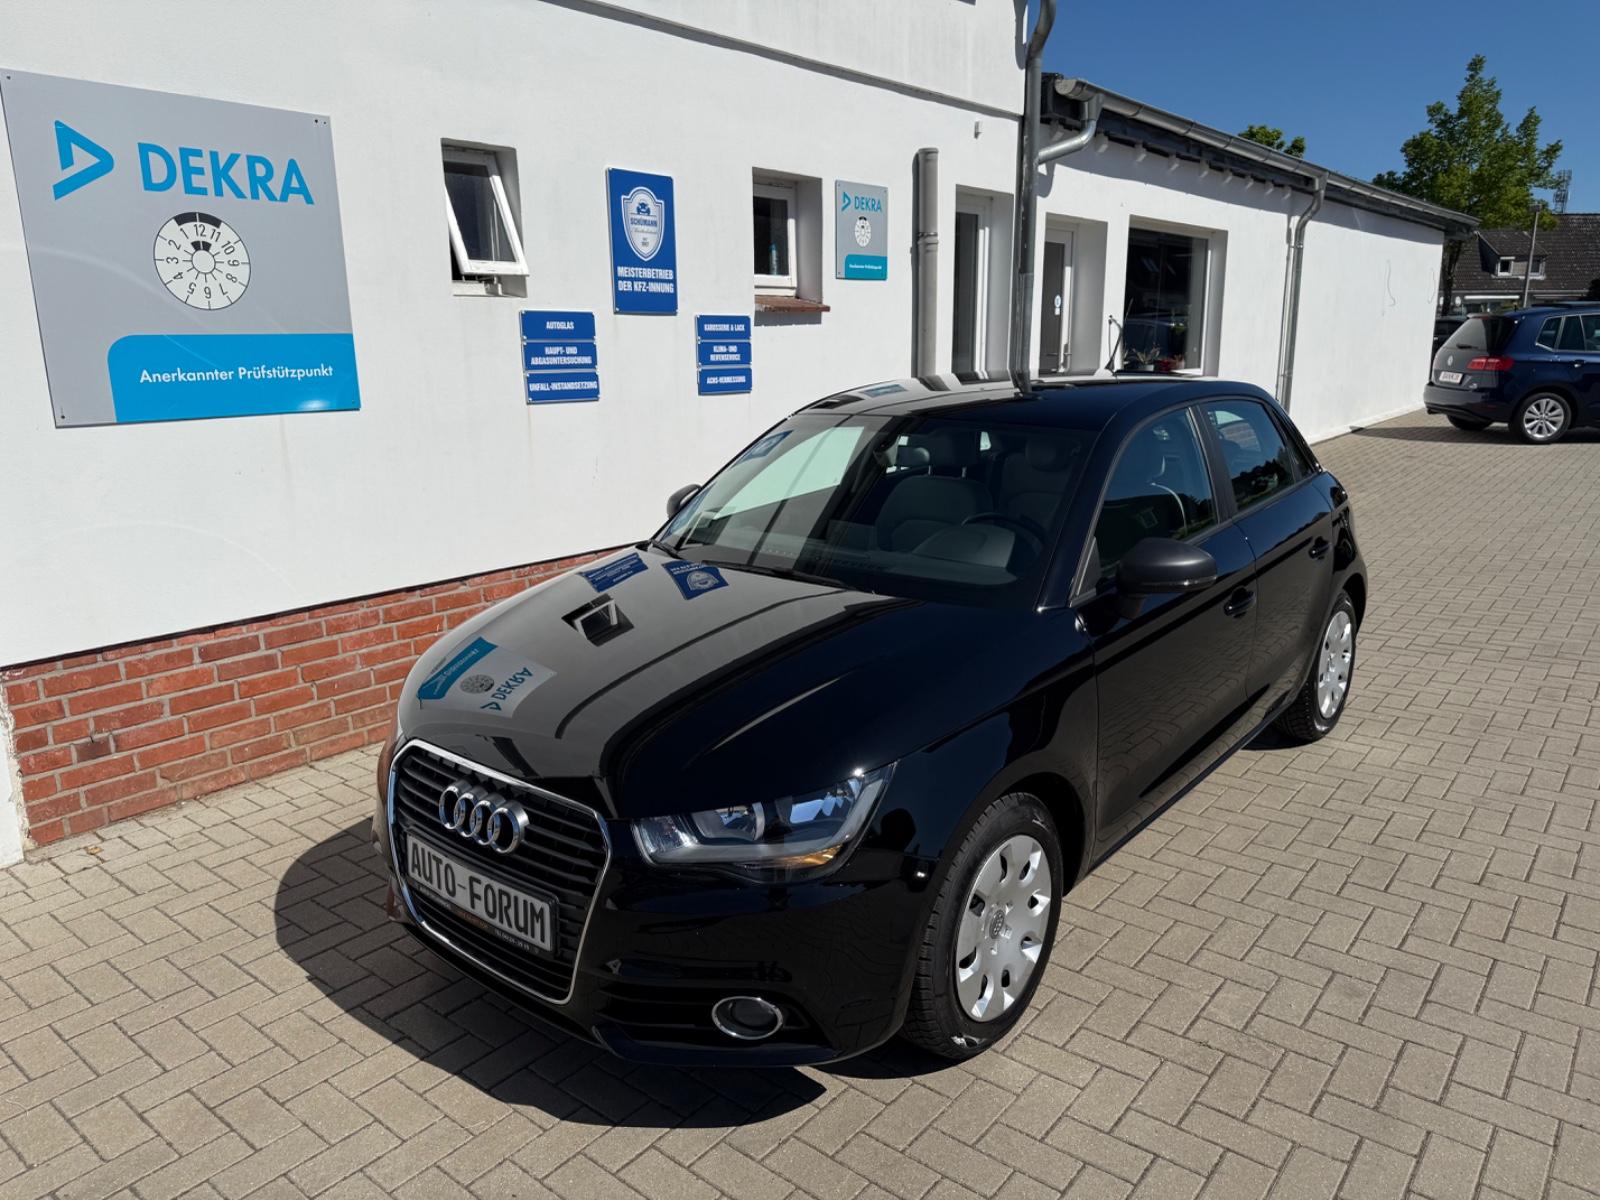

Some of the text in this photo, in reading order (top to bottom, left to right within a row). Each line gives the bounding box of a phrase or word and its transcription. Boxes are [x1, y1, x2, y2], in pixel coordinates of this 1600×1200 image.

[137, 142, 314, 205] DEKRA
[854, 196, 882, 212] DEKRA
[180, 228, 189, 239] 1
[194, 224, 207, 237] 12
[211, 229, 222, 242] 11
[168, 240, 181, 250] 2
[222, 241, 236, 255] 10
[166, 257, 179, 265] 3
[173, 272, 183, 280] 4
[226, 273, 238, 284] 8
[617, 266, 673, 280] MEISTERBETRIEB
[187, 283, 196, 295] 5
[204, 287, 212, 299] 6
[220, 284, 229, 296] 7
[618, 281, 674, 293] DER KFZ-INNUNG
[546, 321, 574, 330] AUTOGLAS
[545, 346, 578, 355] HAUPT- UND
[531, 356, 592, 365] ABGASUNTERSUCHUNG
[139, 365, 333, 384] Anerkannter Prüfstützpunkt
[529, 381, 598, 391] UNFALL-INSTANDSETZUNG
[411, 842, 546, 943] AUTO-FORUM
